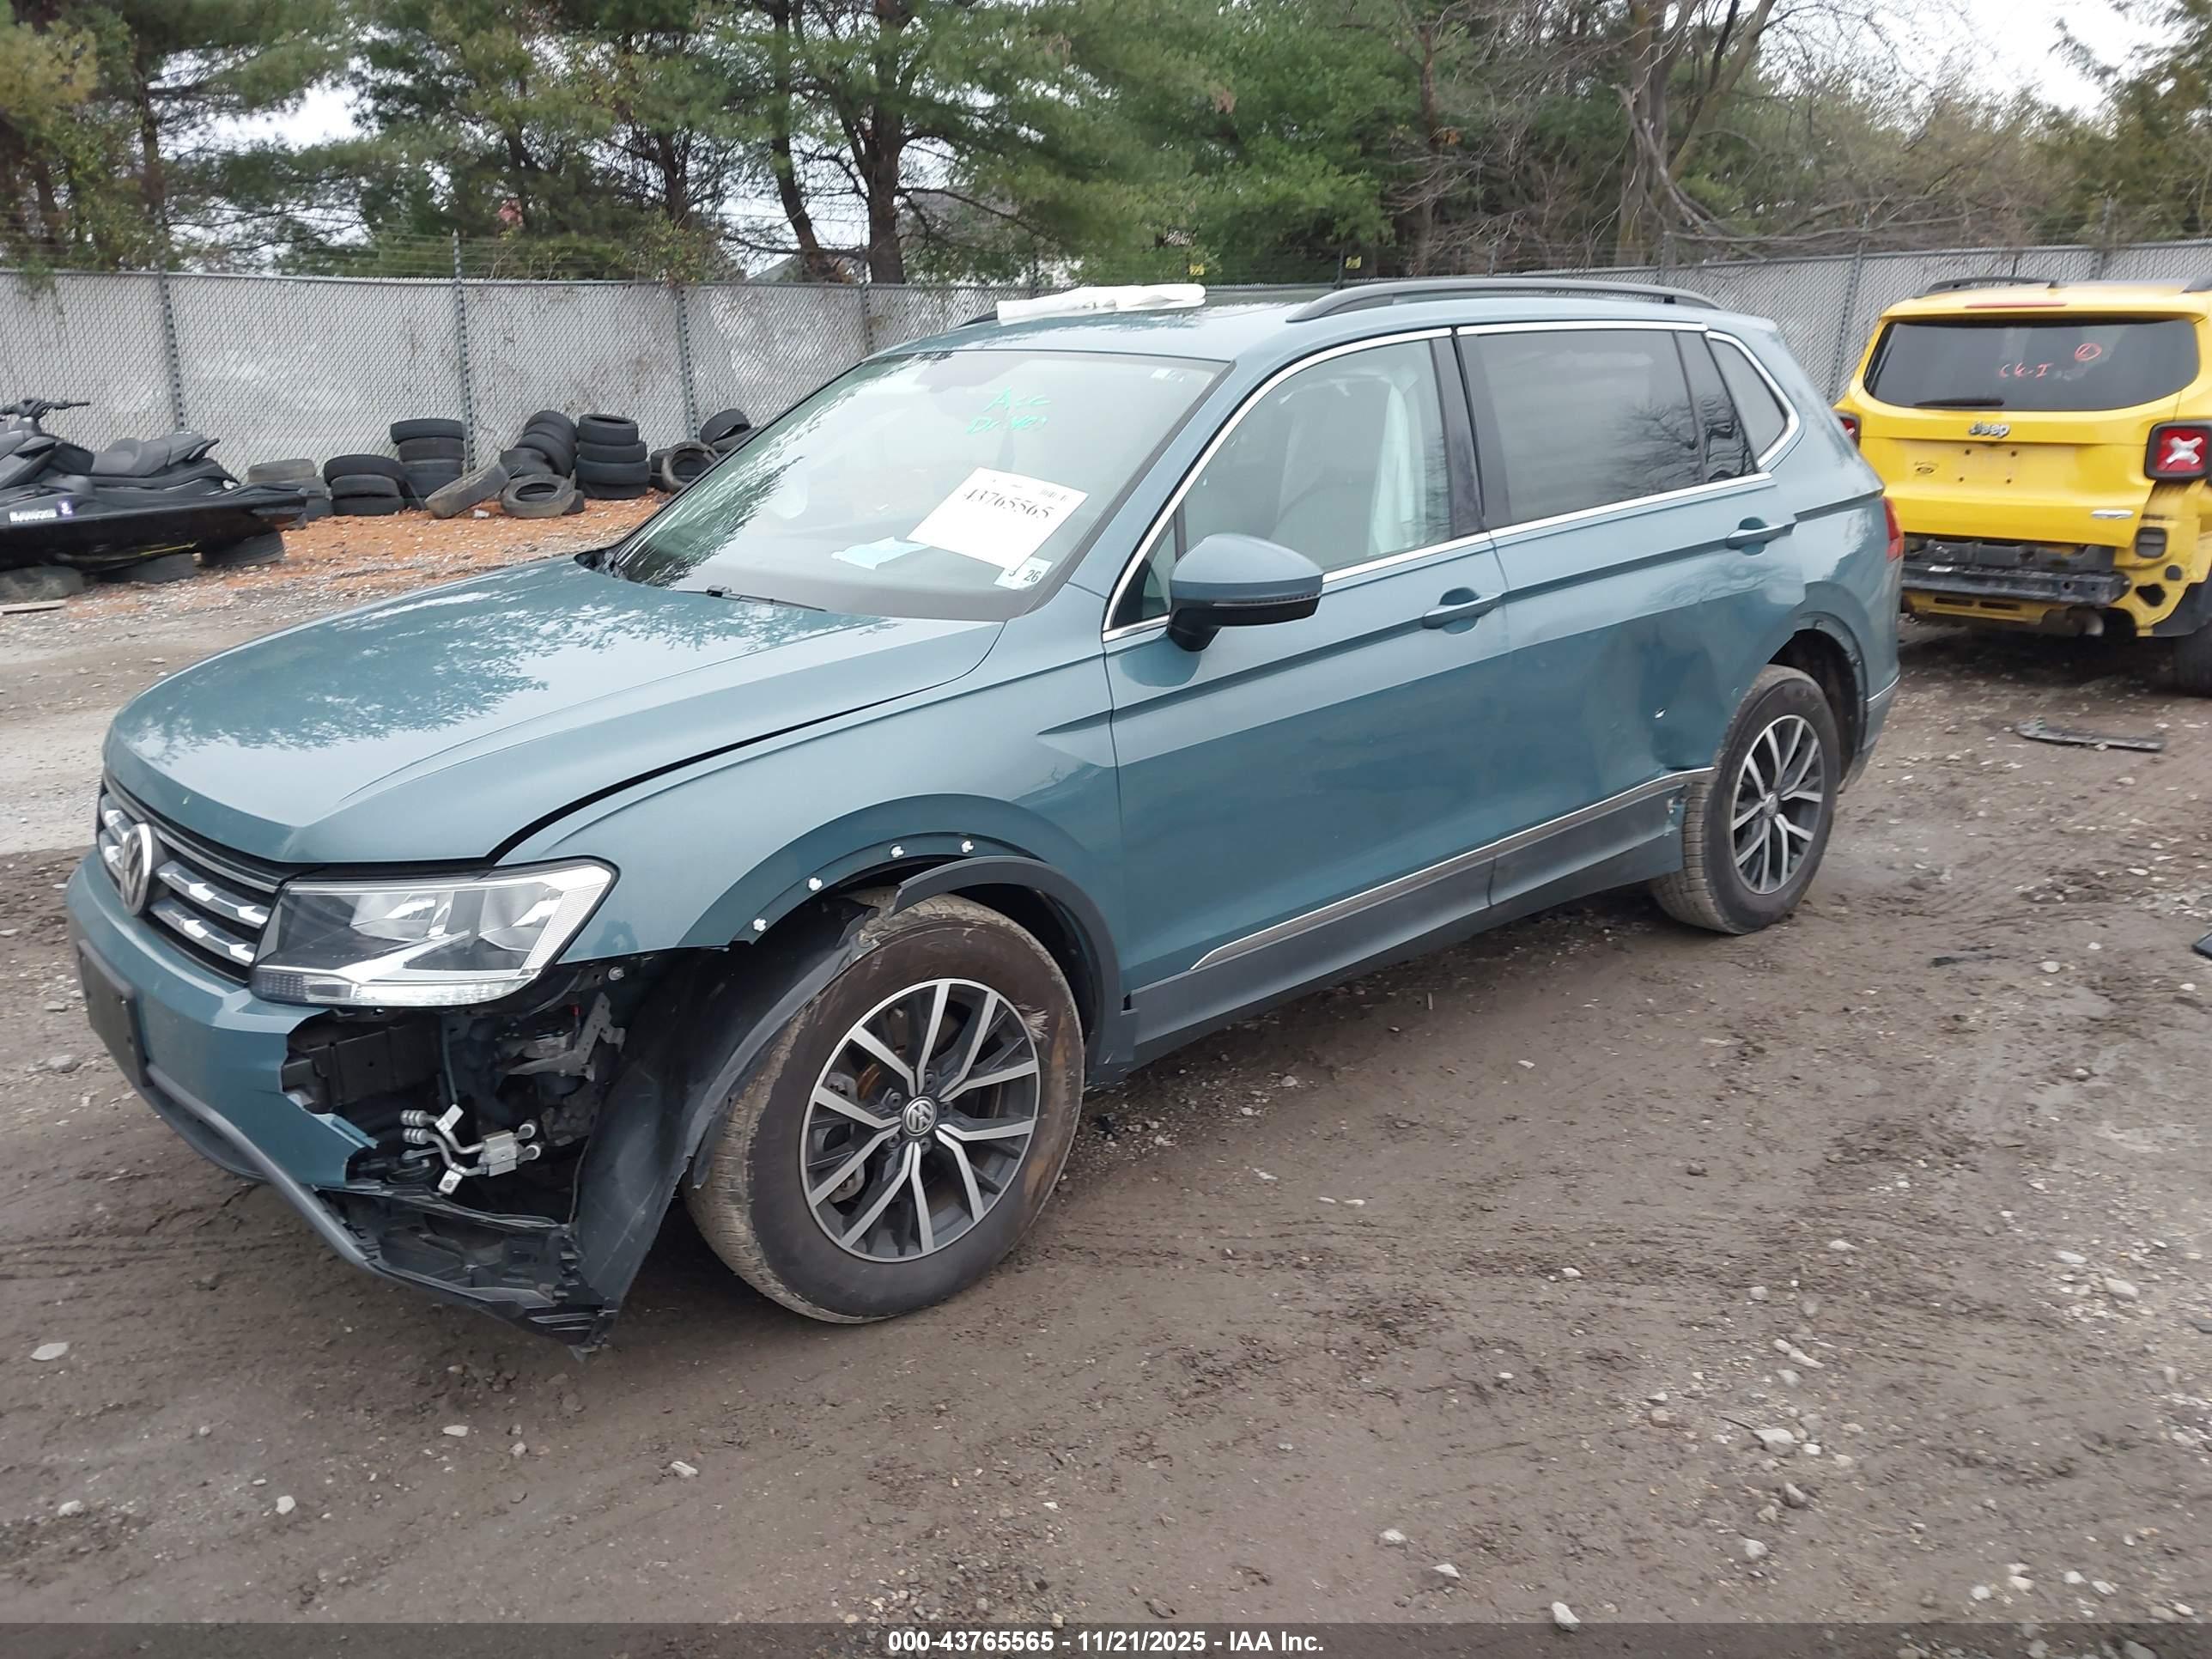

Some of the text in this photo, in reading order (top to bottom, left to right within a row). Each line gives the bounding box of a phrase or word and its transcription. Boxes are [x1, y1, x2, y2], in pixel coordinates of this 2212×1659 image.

[1968, 421, 2010, 439] Jeep
[963, 488, 1055, 520] 43765565
[1024, 569, 1042, 583] 26
